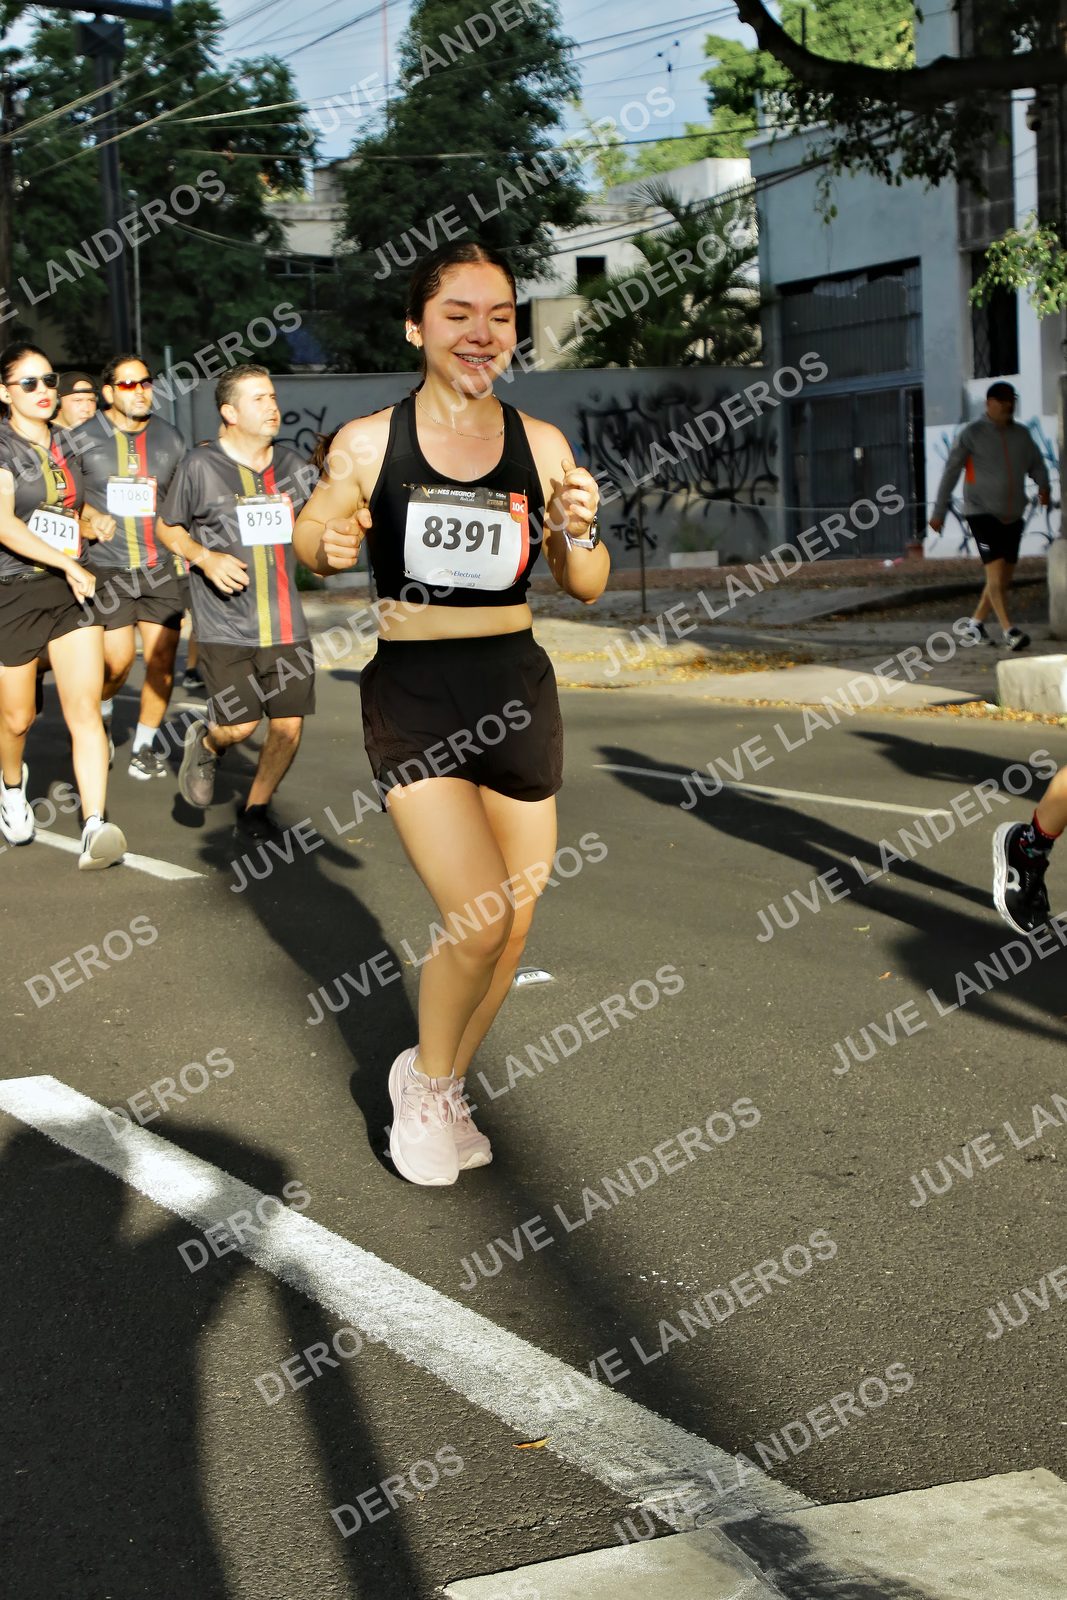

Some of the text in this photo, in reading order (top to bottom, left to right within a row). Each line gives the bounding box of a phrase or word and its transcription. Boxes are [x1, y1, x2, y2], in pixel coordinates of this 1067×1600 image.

[34, 515, 75, 540] 13121
[246, 510, 283, 527] 8795
[421, 515, 502, 556] 8391
